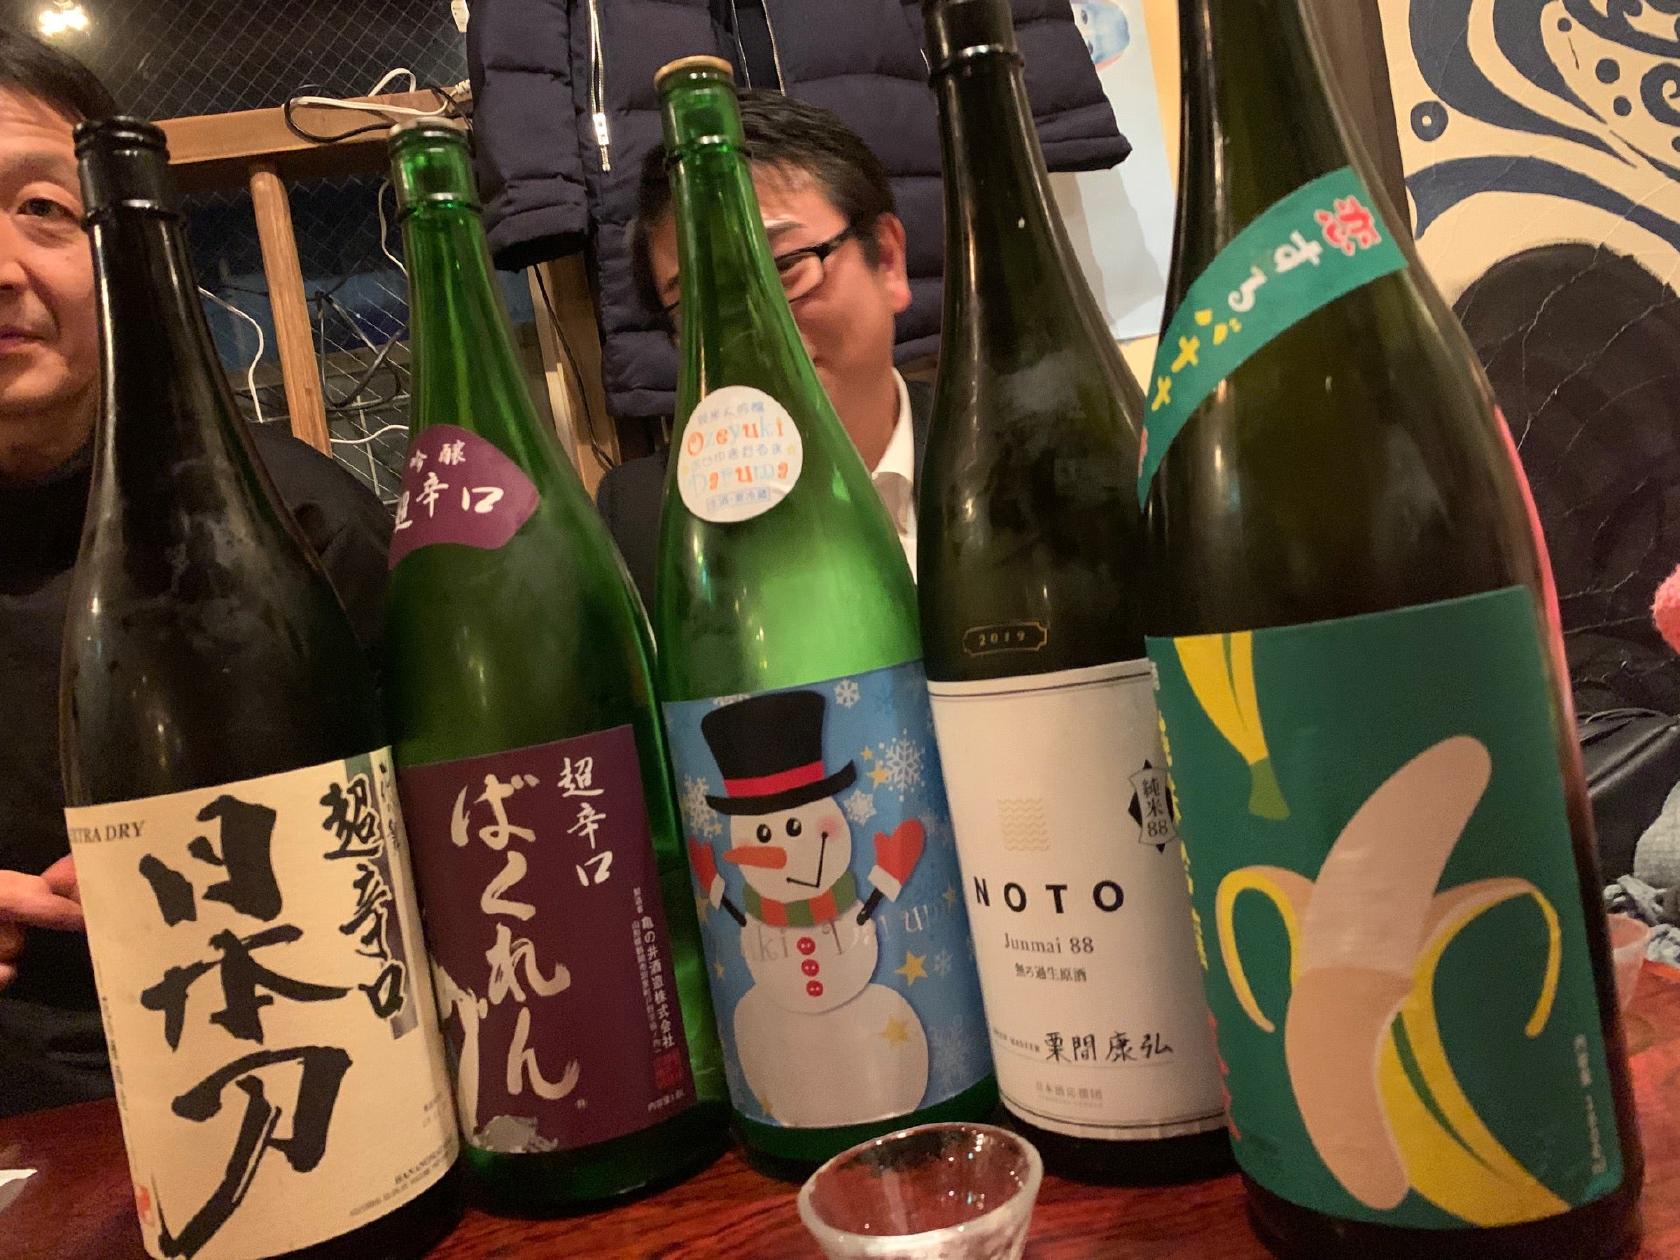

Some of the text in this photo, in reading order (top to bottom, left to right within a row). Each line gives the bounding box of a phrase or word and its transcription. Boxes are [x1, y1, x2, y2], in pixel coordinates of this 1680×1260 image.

[1150, 195, 1382, 412] 恋するバナナ
[978, 630, 1026, 648] 2019
[105, 819, 145, 842] DRY
[558, 757, 613, 889] 超辛口
[451, 773, 580, 1102] ばくれん
[973, 876, 1125, 914] NOTO
[1004, 932, 1094, 954] Junmai 88
[139, 794, 354, 1259] 日本刀
[641, 915, 675, 1049] 亀の井酒造株式会社
